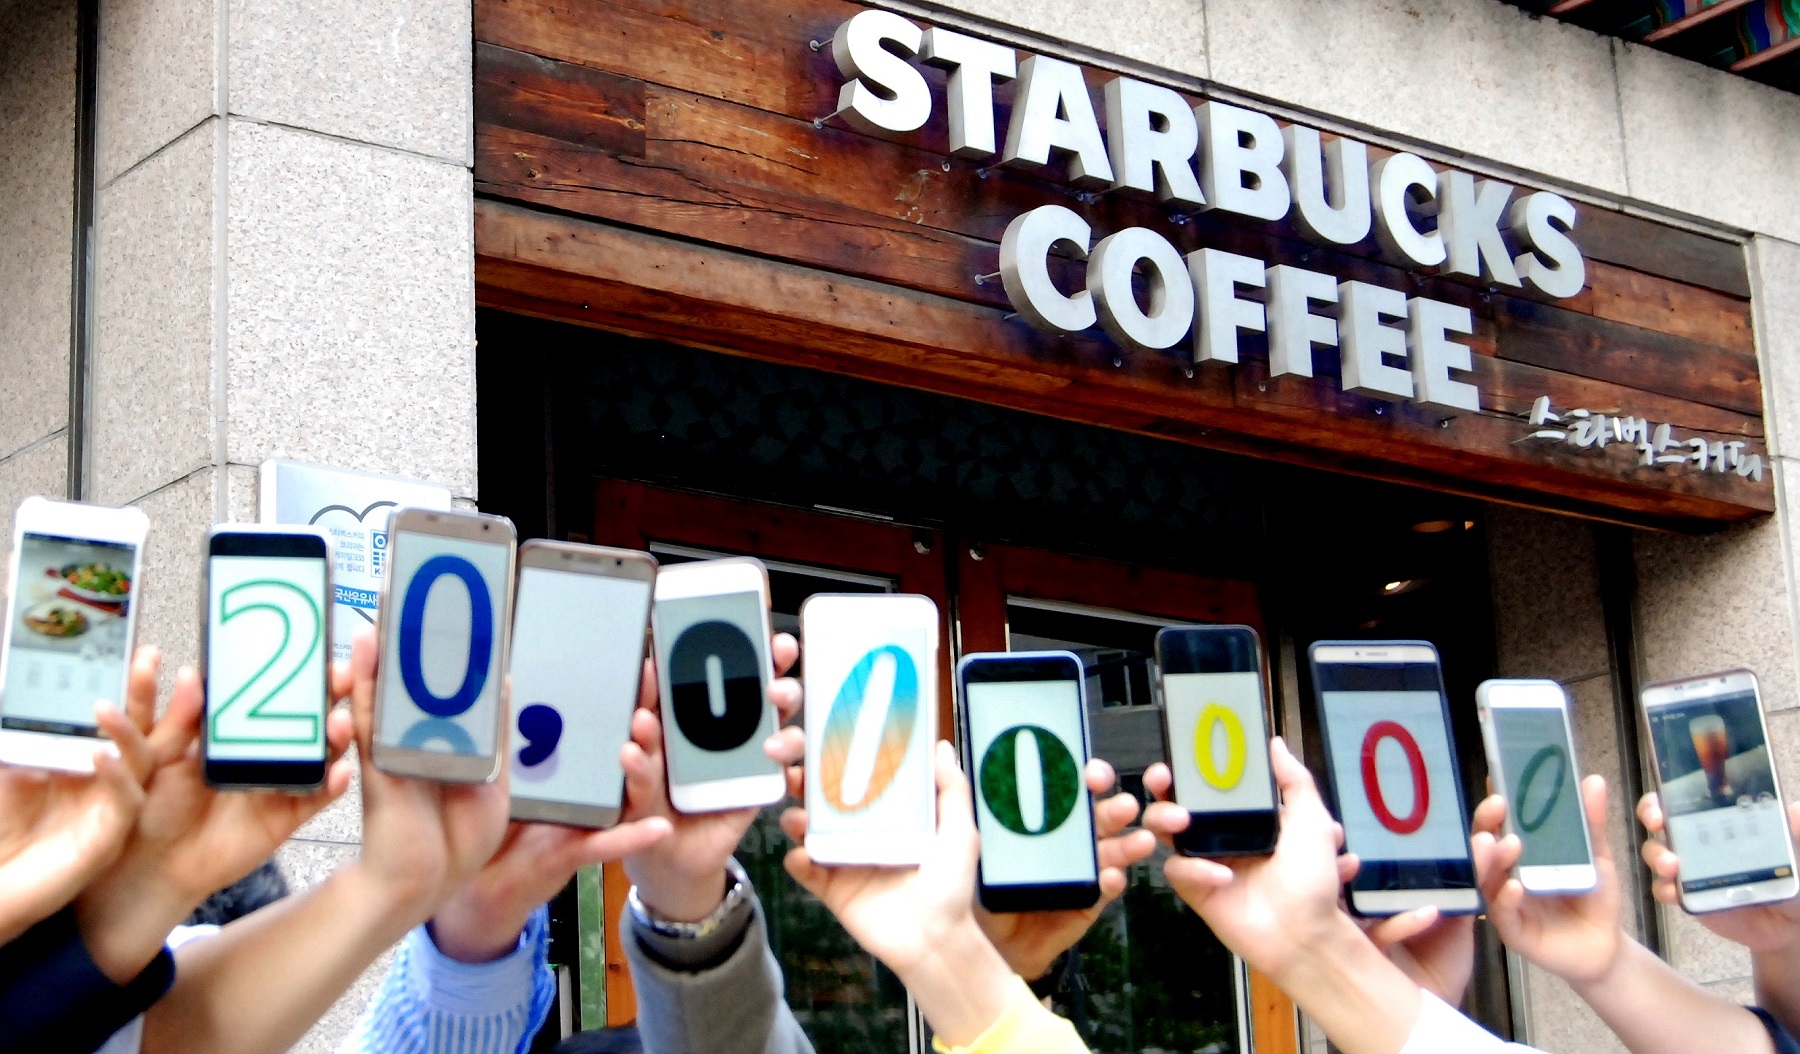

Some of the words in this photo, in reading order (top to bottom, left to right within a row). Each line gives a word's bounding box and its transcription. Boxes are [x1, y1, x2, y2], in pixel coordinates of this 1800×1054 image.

[832, 9, 1586, 299] STARBUCKS
[999, 204, 1480, 412] COFFEE
[1528, 395, 1762, 482] 스타벅스커피
[335, 588, 379, 607] 국산우유사
[400, 554, 494, 718] 0
[210, 578, 322, 744] 2
[669, 620, 763, 752] 0
[819, 644, 919, 814] 0
[980, 724, 1079, 837] 0
[1194, 702, 1247, 791] 0
[1360, 720, 1430, 835] 0
[1516, 744, 1566, 833] 0
